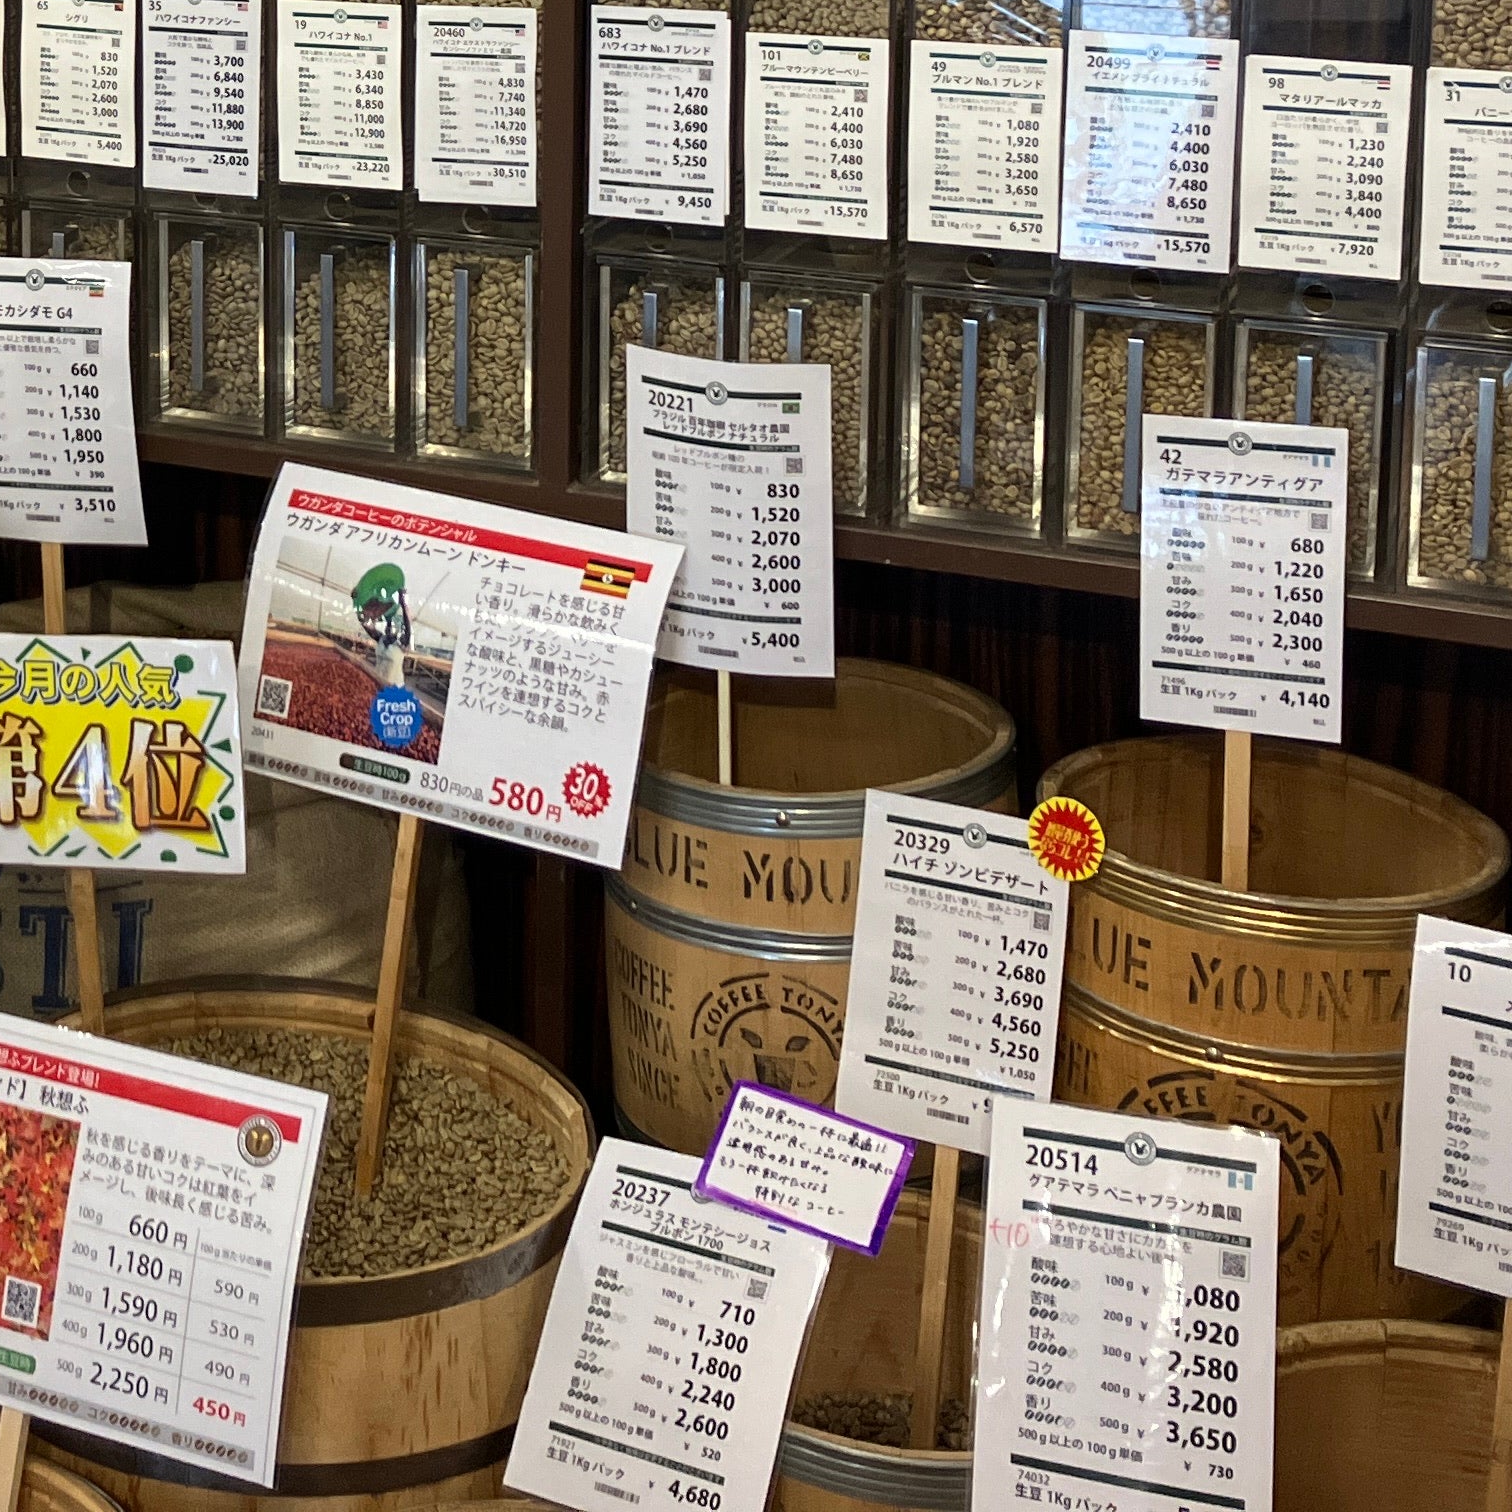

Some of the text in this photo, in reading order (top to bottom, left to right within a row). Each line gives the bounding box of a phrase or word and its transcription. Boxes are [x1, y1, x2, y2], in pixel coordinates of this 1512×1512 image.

[602, 42, 710, 56] ハワイコナ No.1 ブレンド
[1087, 55, 1131, 70] 20499
[976, 76, 998, 87] No.1
[1002, 77, 1042, 88] ブレンド
[213, 155, 249, 167] 25,020
[830, 206, 868, 218] 15,570
[1345, 207, 1382, 219] 4,400
[1009, 222, 1042, 234] 6,570
[56, 306, 73, 321] G4
[648, 389, 694, 413] 20221
[61, 406, 100, 422] 1,530
[288, 513, 344, 536] ウガンダ
[467, 550, 525, 574] ドンキー
[377, 699, 415, 714] Fresh
[1279, 690, 1330, 709] 4,140
[380, 712, 413, 727] Crop
[489, 777, 562, 822] 580円
[894, 830, 950, 854] 20329
[894, 852, 938, 872] ハイチ
[996, 961, 1046, 986] 2,680
[1447, 961, 1472, 983] 10
[40, 1084, 89, 1115] 秋想ふ
[1026, 1144, 1099, 1177] 20514
[612, 1179, 671, 1207] 20237
[1029, 1173, 1100, 1199] グアテマラ
[690, 1352, 741, 1382] 1,800
[1167, 1385, 1238, 1418] 3,200
[669, 1479, 721, 1511] 4,680
